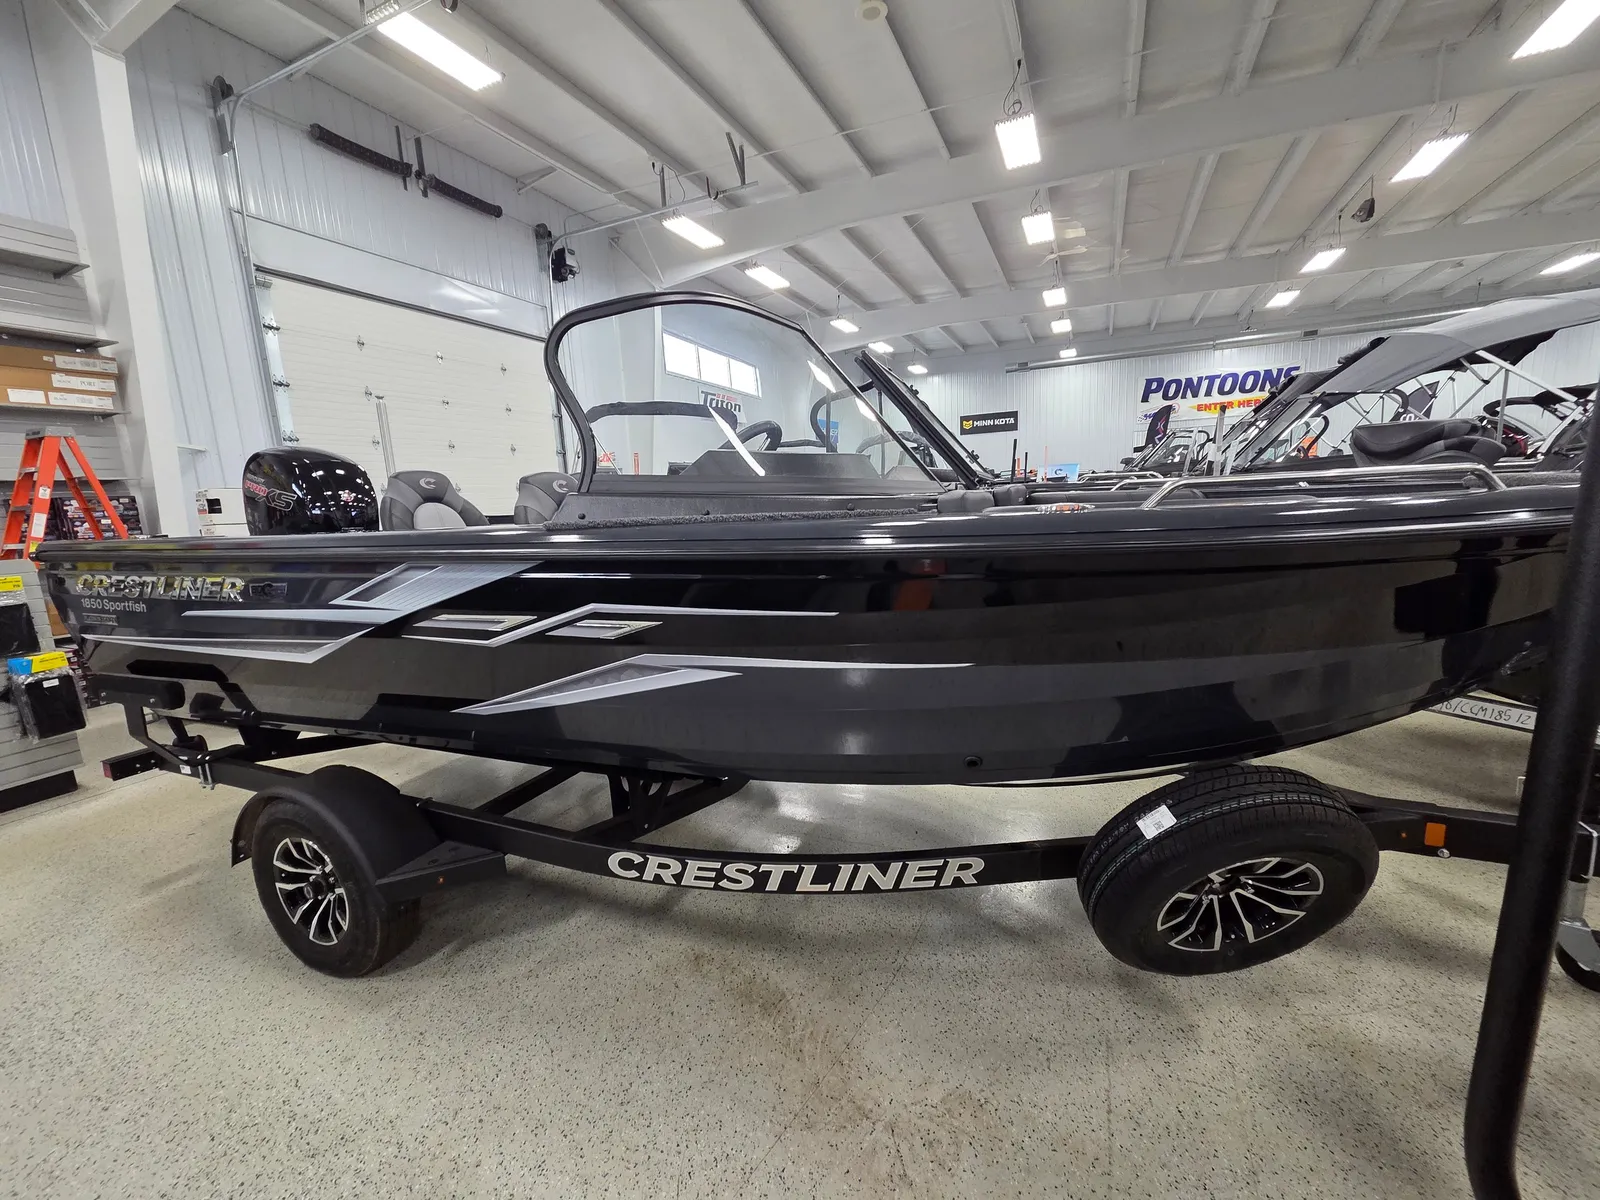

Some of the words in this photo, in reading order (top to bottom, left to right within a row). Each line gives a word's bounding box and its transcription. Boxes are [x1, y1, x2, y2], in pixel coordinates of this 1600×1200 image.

[701, 390, 741, 412] Triton
[1238, 398, 1266, 408] HER
[973, 419, 993, 427] MINN
[994, 417, 1015, 425] KOTA
[76, 574, 245, 602] CRESTLINER
[81, 598, 101, 610] 1850
[103, 600, 147, 613] Sportfish
[607, 851, 985, 893] CRESTLINER
